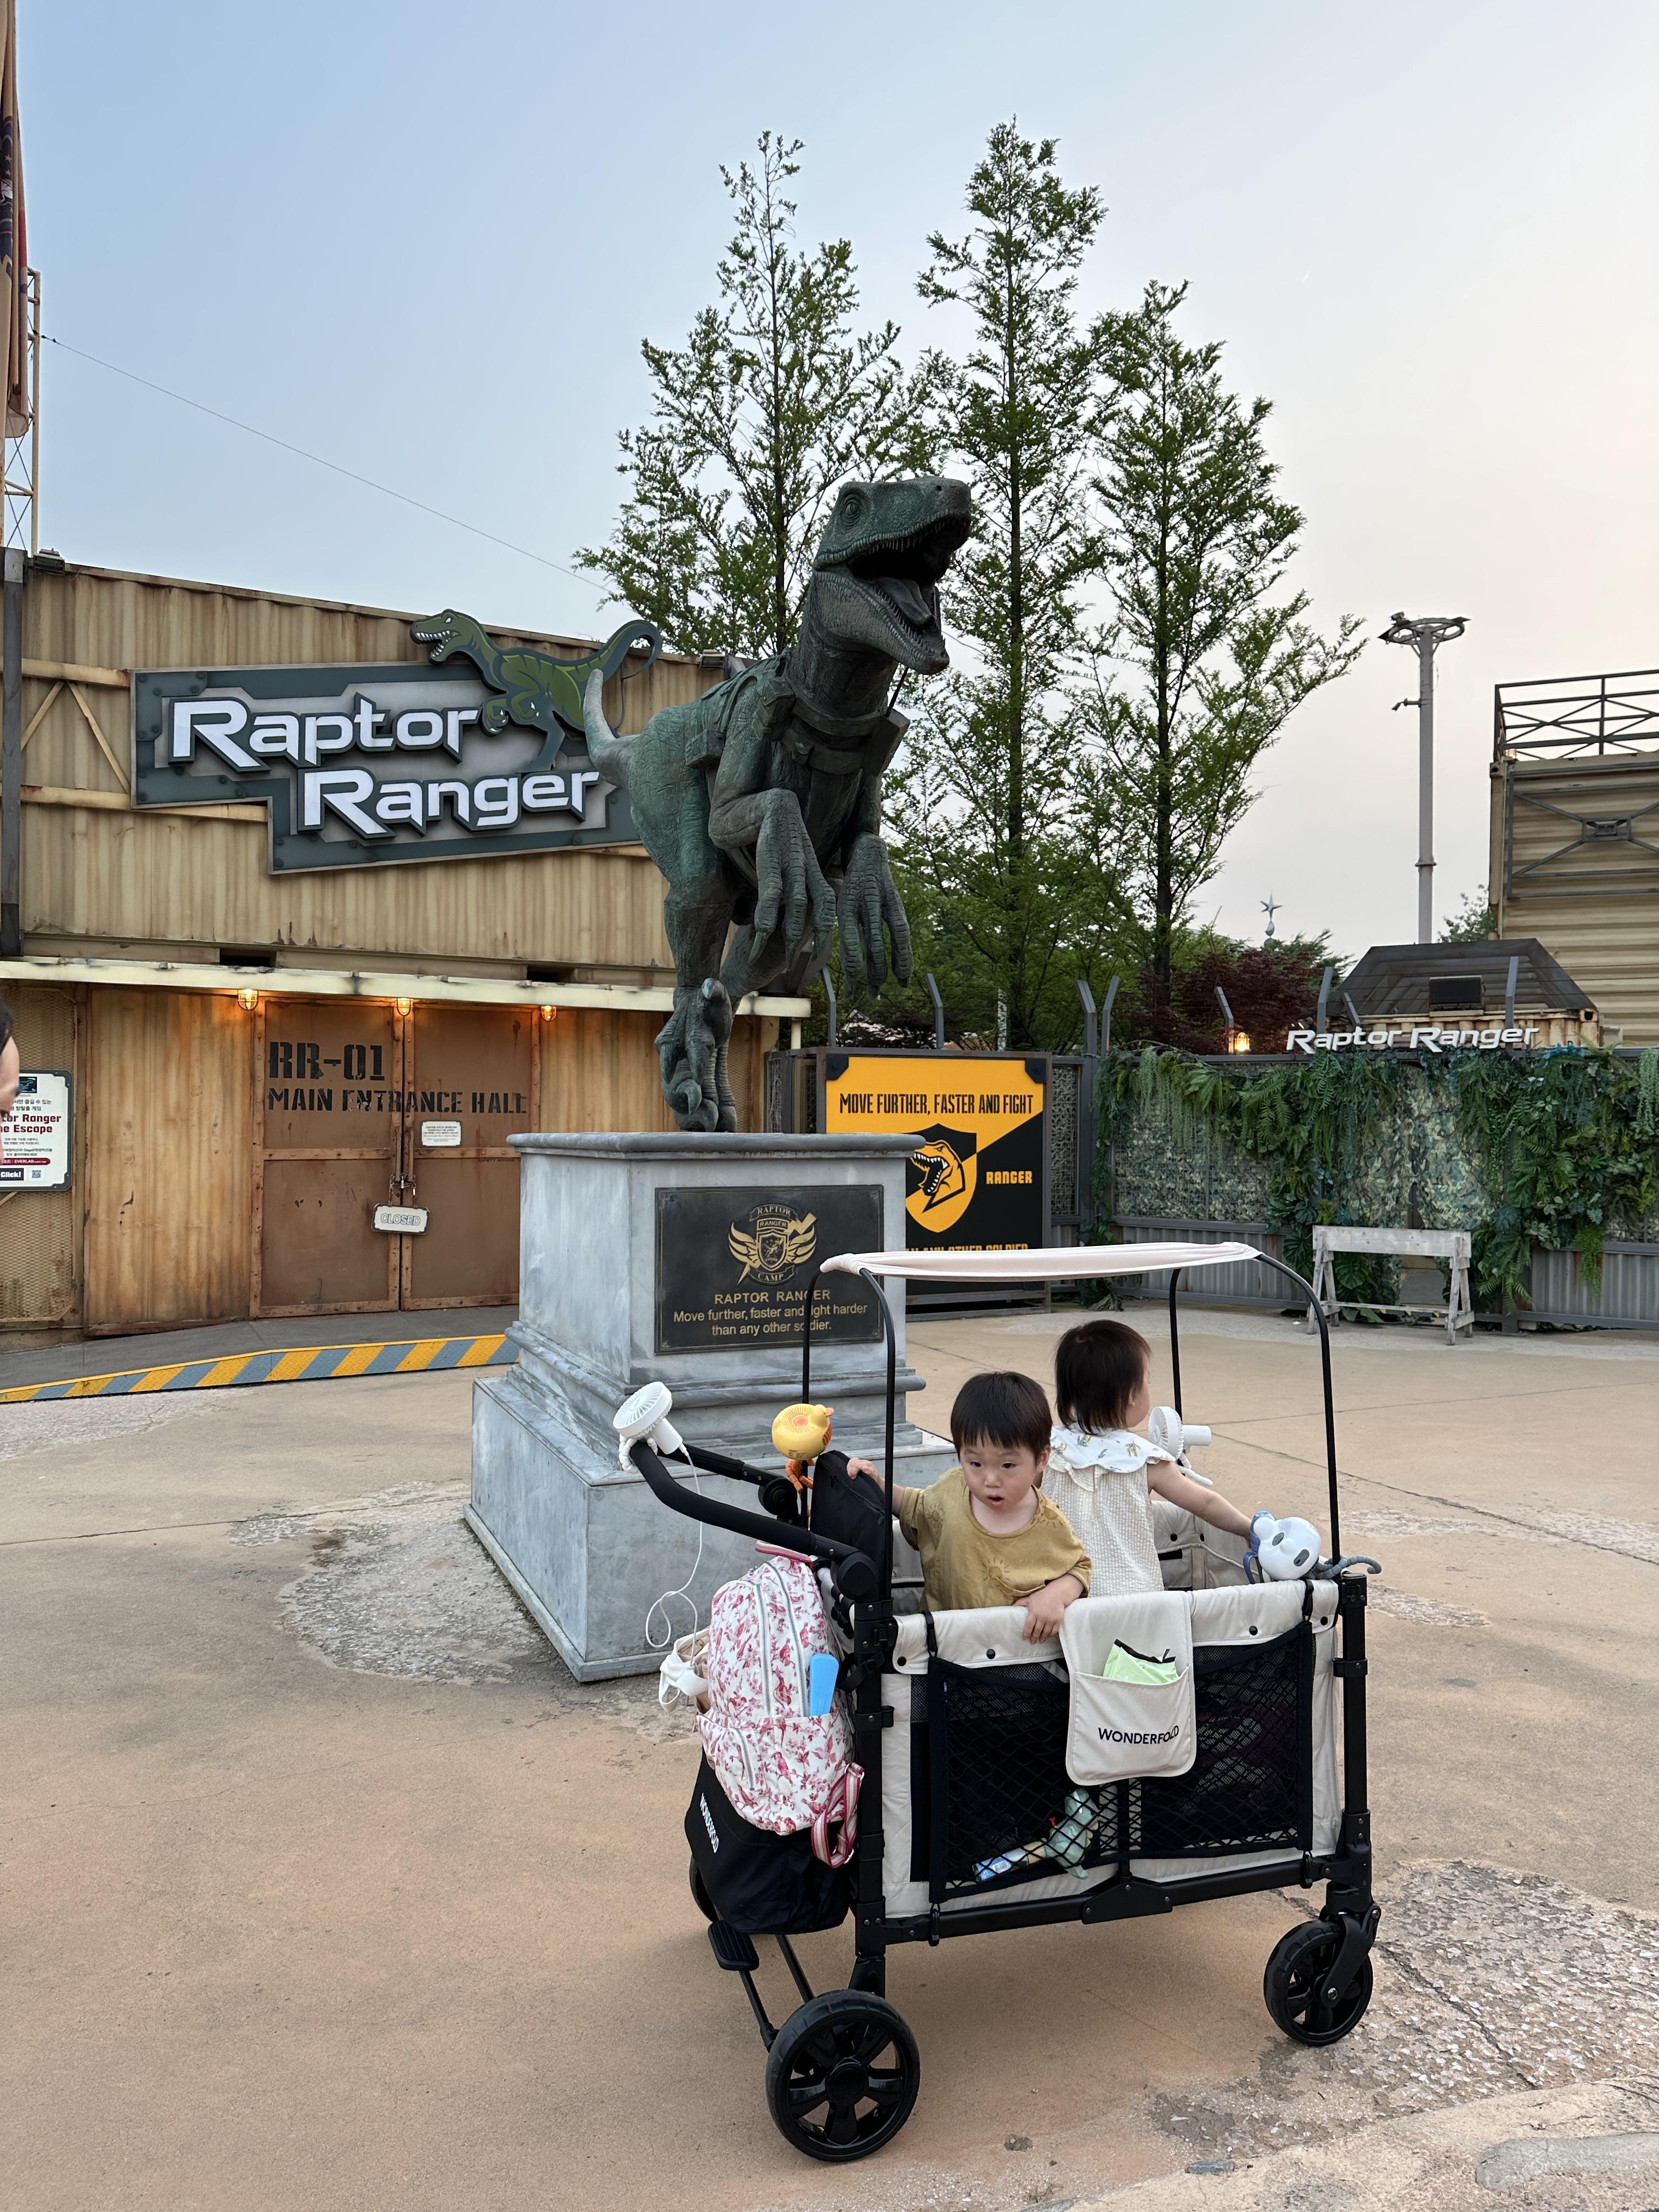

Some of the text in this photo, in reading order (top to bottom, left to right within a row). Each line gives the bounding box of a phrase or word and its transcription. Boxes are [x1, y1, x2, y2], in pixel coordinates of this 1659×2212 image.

[172, 697, 478, 768] Raptor
[303, 768, 600, 834] Ranger
[1285, 1026, 1539, 1054] Raptor Ranger
[268, 1041, 385, 1081] RR-01
[268, 1088, 527, 1114] MAIN ENTRANCE HALL
[839, 1093, 1034, 1116] MOVE FURTHER, FASTER AND FIGHT
[22, 1114, 61, 1124] Ranger
[13, 1124, 53, 1134] Escape
[986, 1171, 1032, 1184] RANGER
[381, 1212, 421, 1226] CLOSED
[758, 1206, 791, 1216] RAPTOR
[758, 1273, 784, 1282] CAMP
[715, 1291, 769, 1305] RAPTOR
[674, 1302, 867, 1323] Move further, faster and ight harder
[712, 1320, 832, 1336] than any other sodier.
[1098, 1725, 1179, 1744] WONDERFOLD
